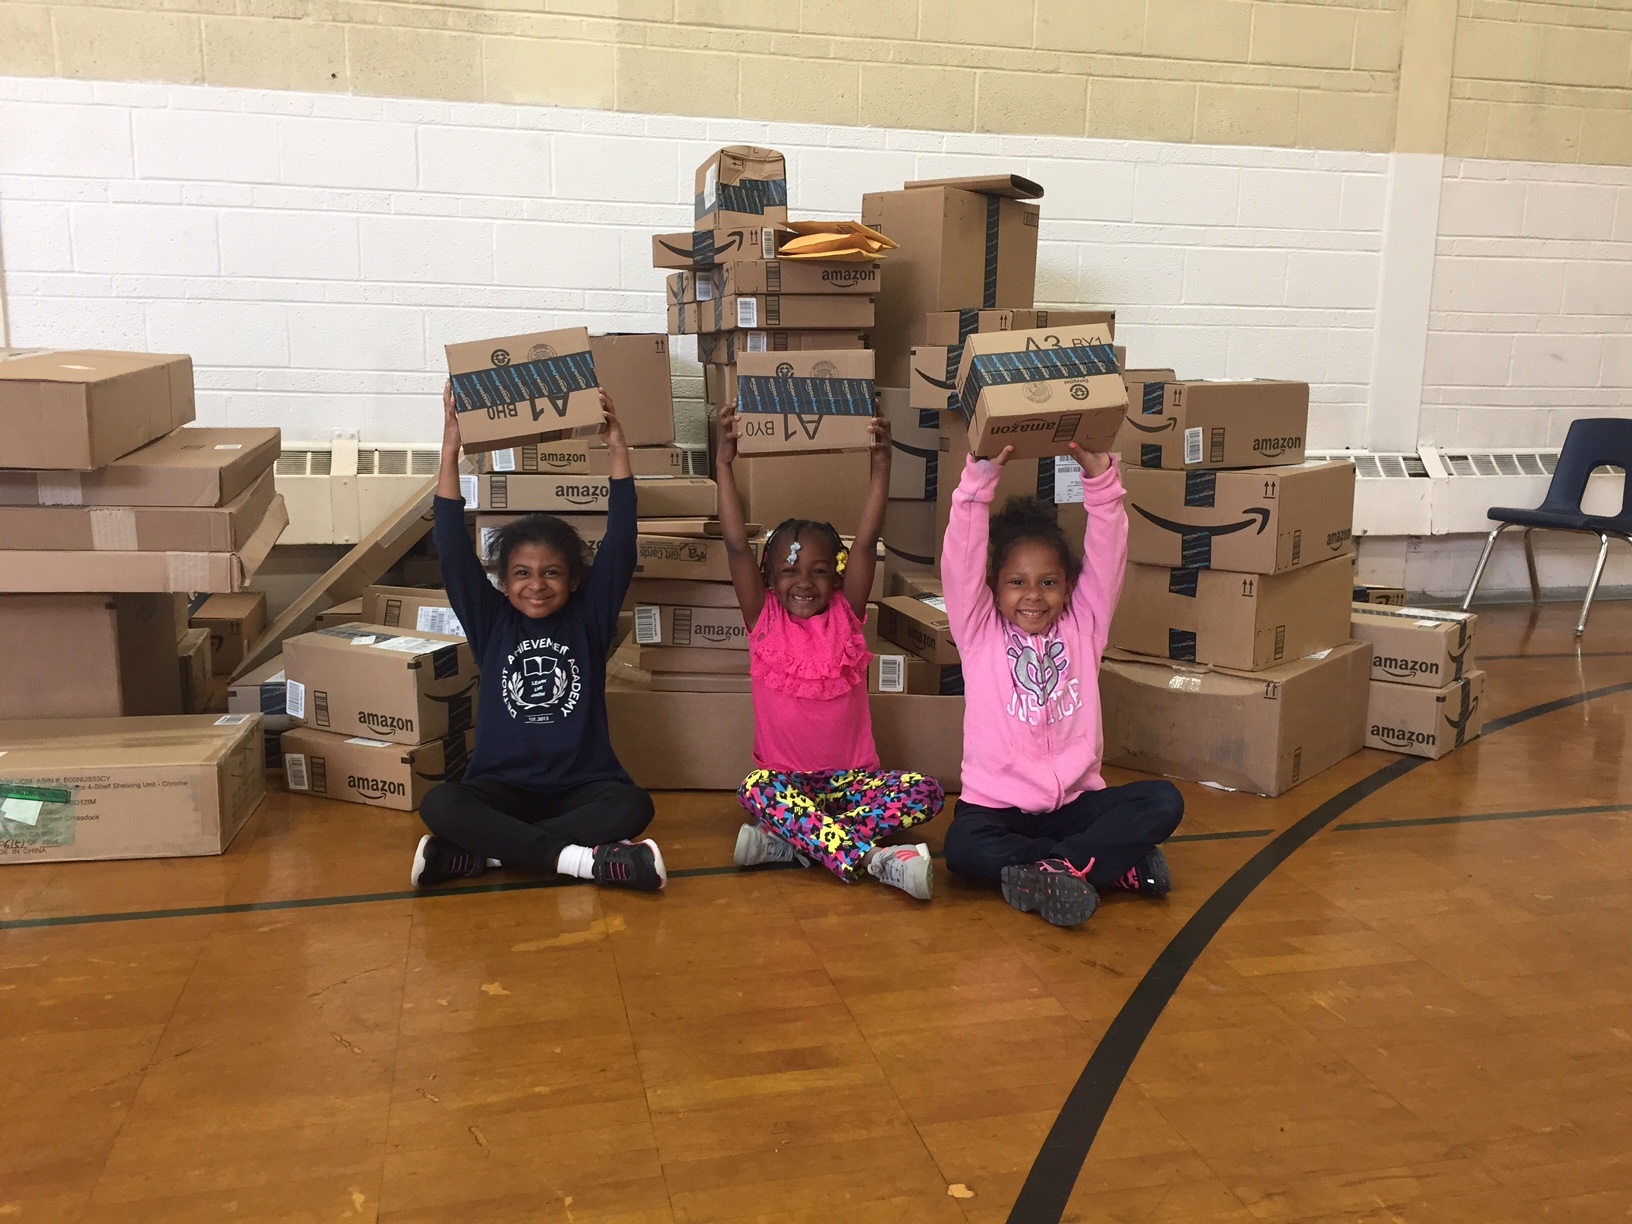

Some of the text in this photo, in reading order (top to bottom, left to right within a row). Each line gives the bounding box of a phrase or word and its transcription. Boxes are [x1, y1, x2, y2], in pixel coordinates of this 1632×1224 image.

[822, 270, 876, 281] amazon
[784, 414, 824, 441] A1
[991, 421, 1056, 435] amazon
[1253, 436, 1301, 450] amazon
[540, 452, 586, 463] amazon
[556, 485, 609, 497] amazo
[1326, 528, 1350, 544] amazon
[640, 548, 679, 560] Gift Cards
[907, 626, 936, 650] amazon
[1373, 656, 1440, 674] amazon
[502, 667, 518, 718] DETROIT
[561, 658, 581, 717] ACADEMY
[358, 710, 414, 732] amazon
[1371, 724, 1436, 745] amazon
[112, 782, 141, 790] Shelving
[348, 775, 406, 796] amazon
